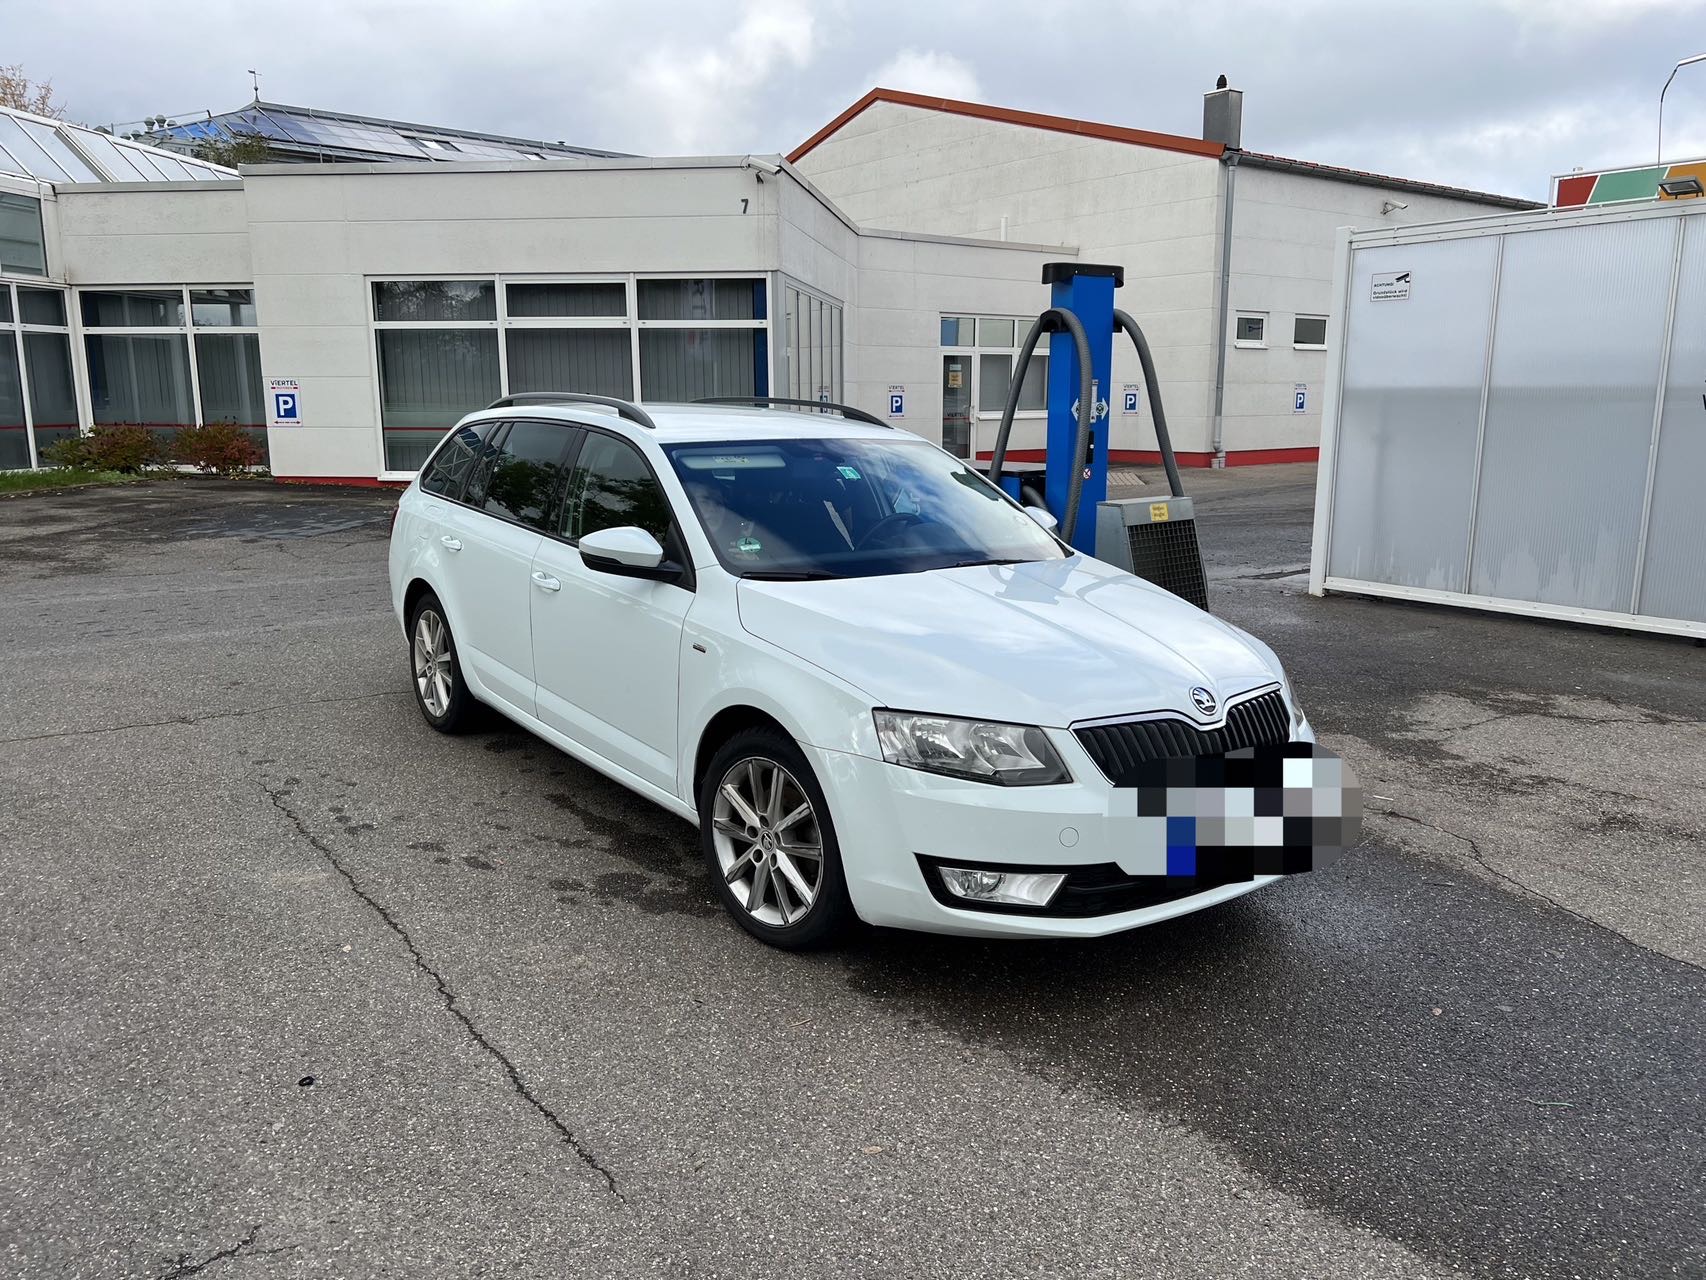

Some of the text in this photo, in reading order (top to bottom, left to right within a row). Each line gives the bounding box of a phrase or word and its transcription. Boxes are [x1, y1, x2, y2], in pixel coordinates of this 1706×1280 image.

[741, 198, 749, 214] 7
[278, 396, 294, 417] P
[892, 397, 902, 411] P
[1126, 395, 1136, 409] P
[1296, 393, 1304, 408] P
